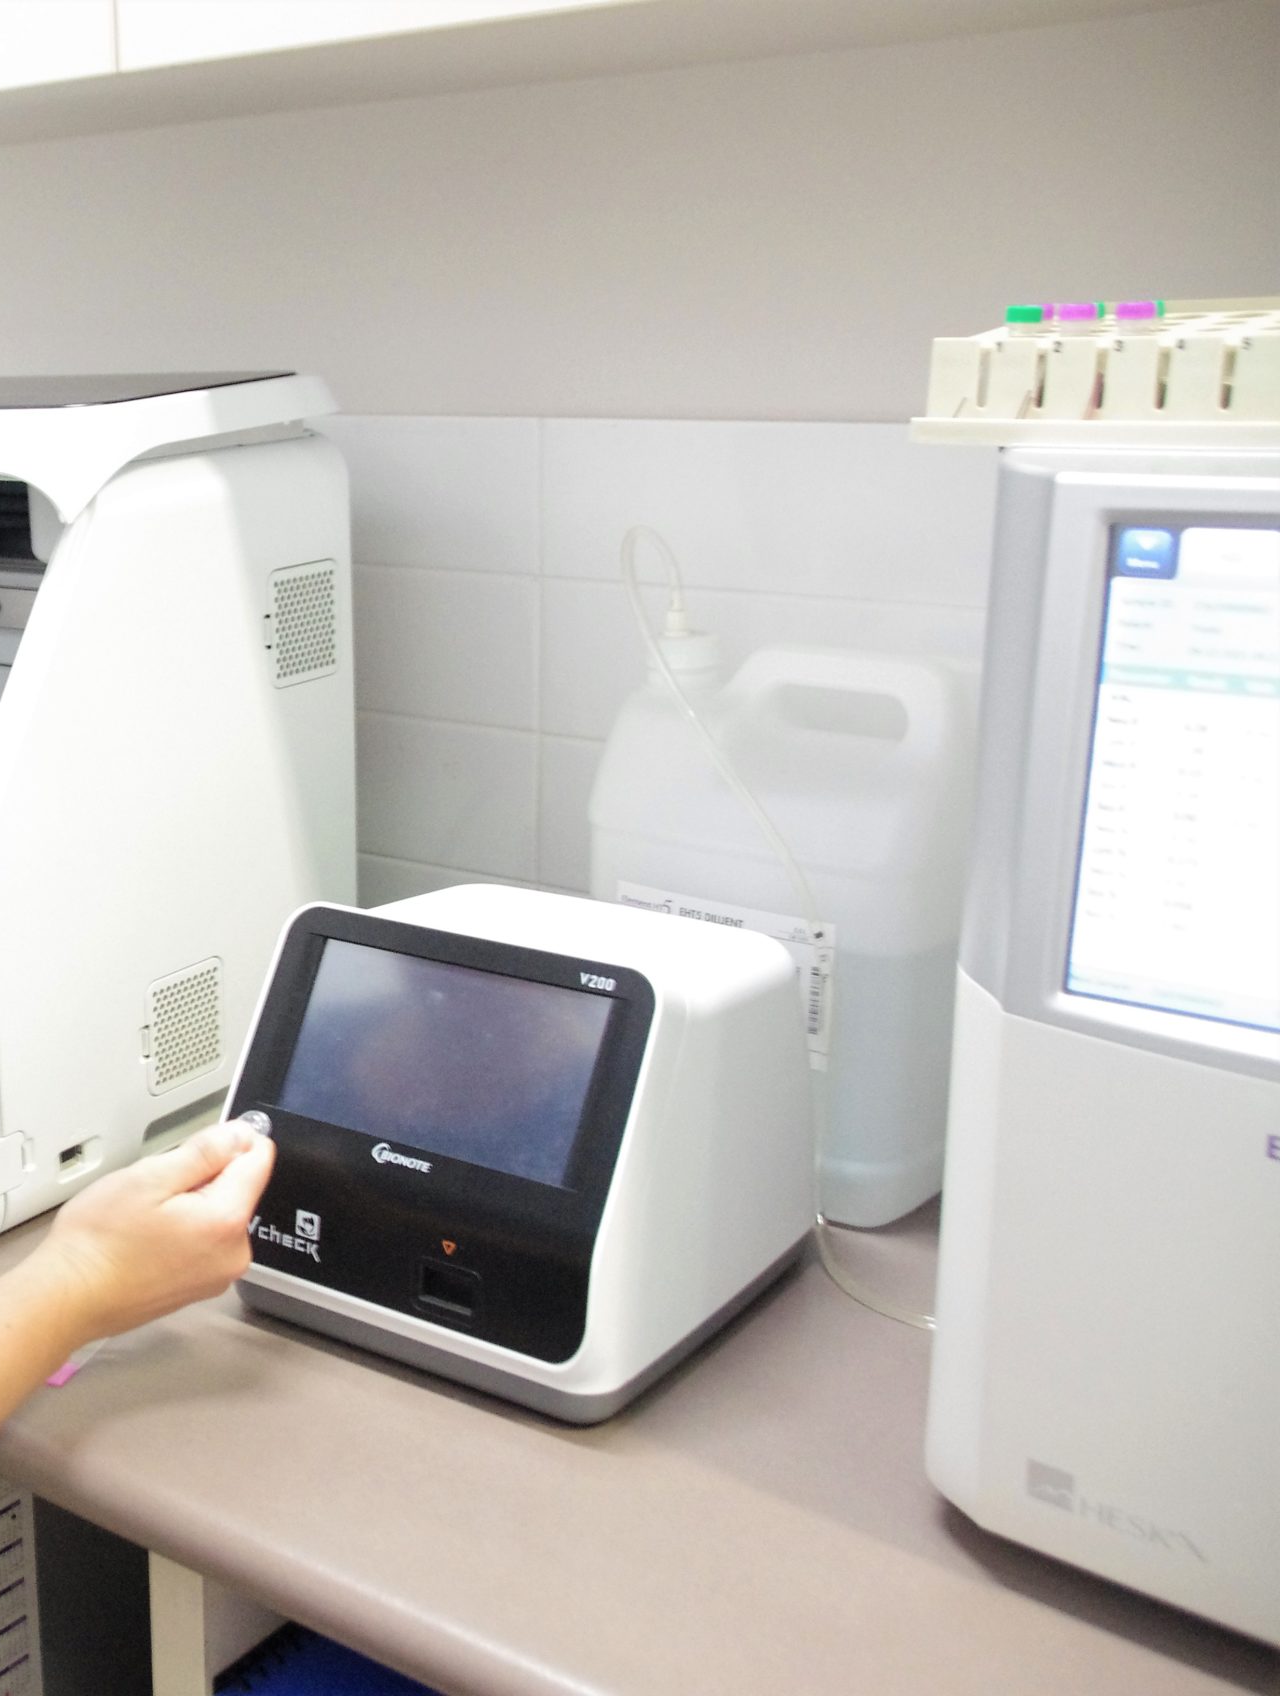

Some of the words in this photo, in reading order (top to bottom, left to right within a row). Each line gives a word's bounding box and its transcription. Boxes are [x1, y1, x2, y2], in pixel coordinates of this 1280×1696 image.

[704, 912, 744, 929] DILUENT
[579, 971, 617, 992] V200
[379, 1149, 433, 1174] BIONOTE
